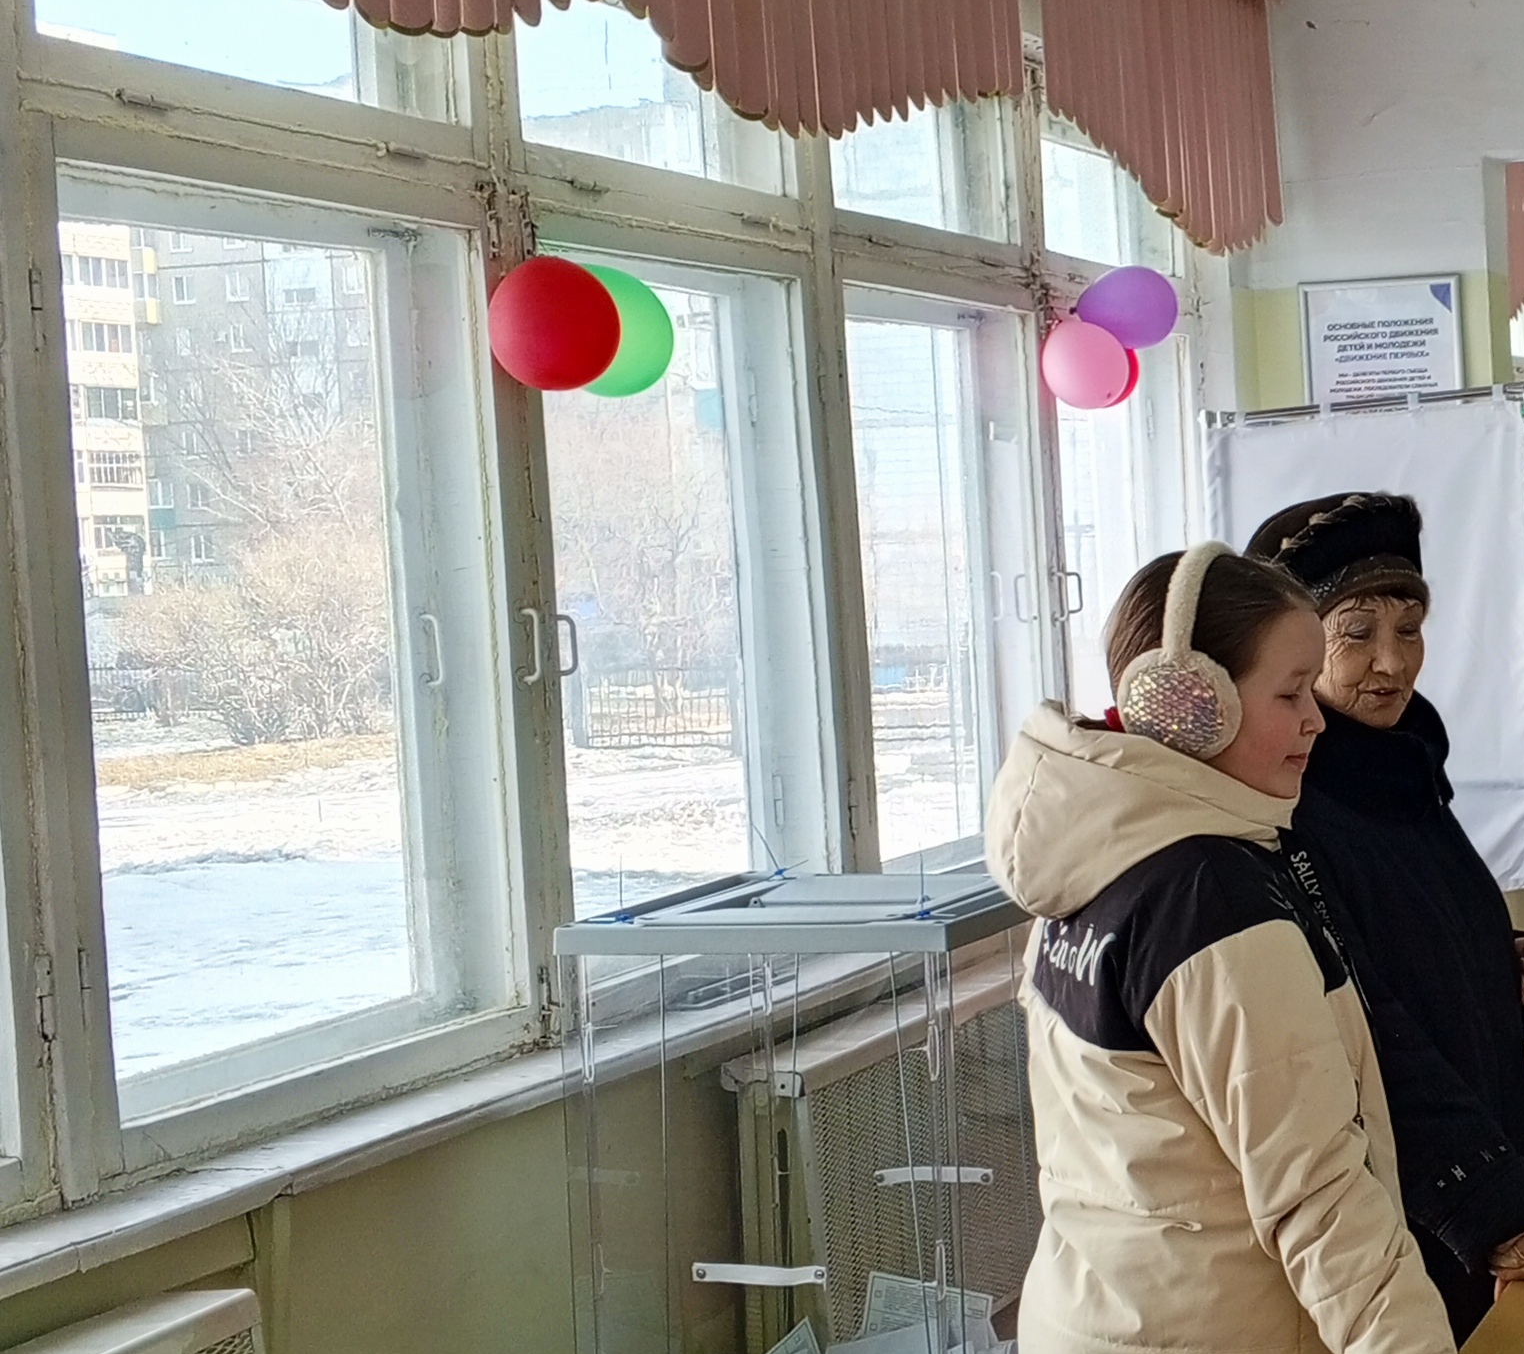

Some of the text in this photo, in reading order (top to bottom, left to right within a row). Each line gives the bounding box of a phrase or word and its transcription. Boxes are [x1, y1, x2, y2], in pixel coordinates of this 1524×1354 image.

[1326, 317, 1434, 332] ОСНОВНЫЕ ПОЛОЖЕНИЯ
[1323, 327, 1439, 342] РОССИЙСКОГО ДВИЖЕНИЯ
[1336, 339, 1426, 353] ДЕТЕЙ И МОЛОДЕЖИ
[1290, 850, 1322, 897] SALLY
